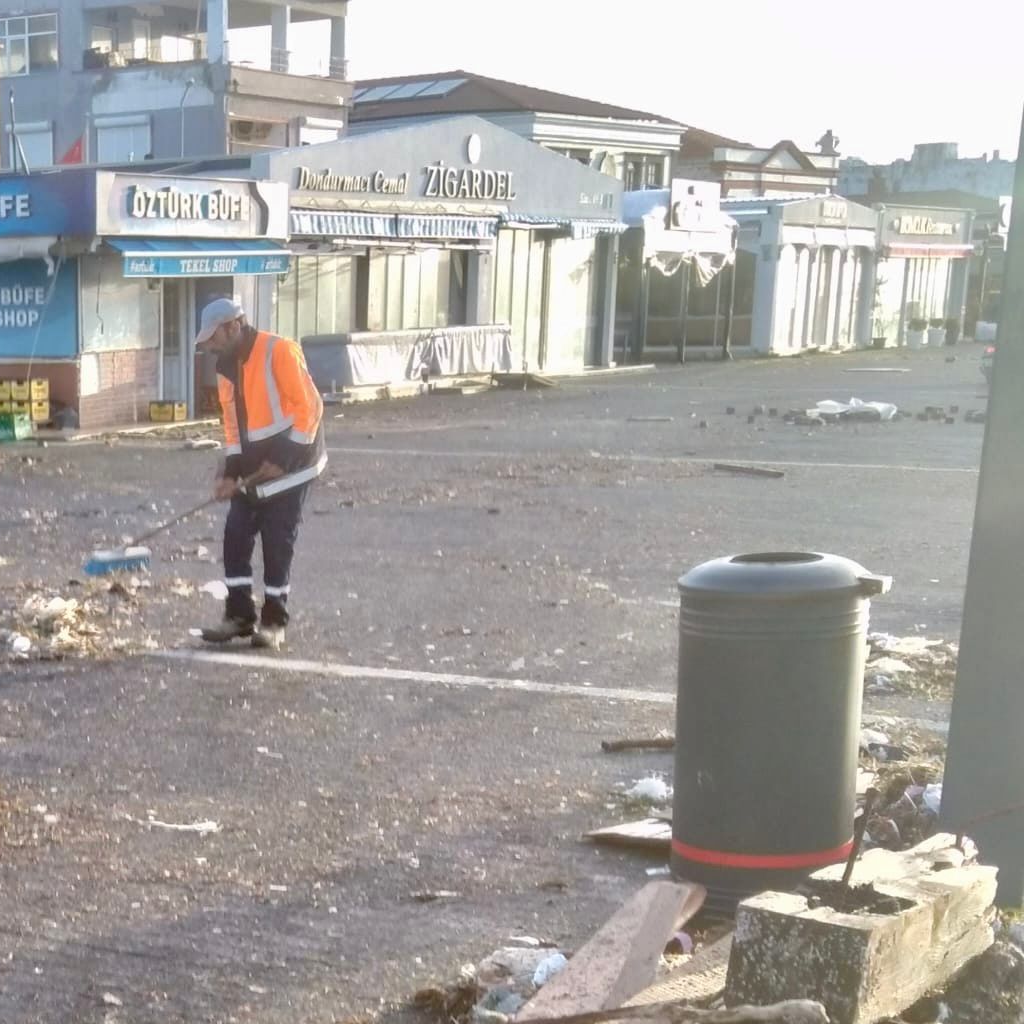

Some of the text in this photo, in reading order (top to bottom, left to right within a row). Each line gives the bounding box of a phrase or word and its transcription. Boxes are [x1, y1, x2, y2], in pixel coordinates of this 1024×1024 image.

[298, 166, 410, 195] Dondurmacı Cemal
[425, 160, 516, 201] ZİGARDEL
[132, 184, 204, 219] ÖZTÜRK
[179, 258, 238, 273] TEKEL SHOP
[0, 284, 45, 305] BÜFE
